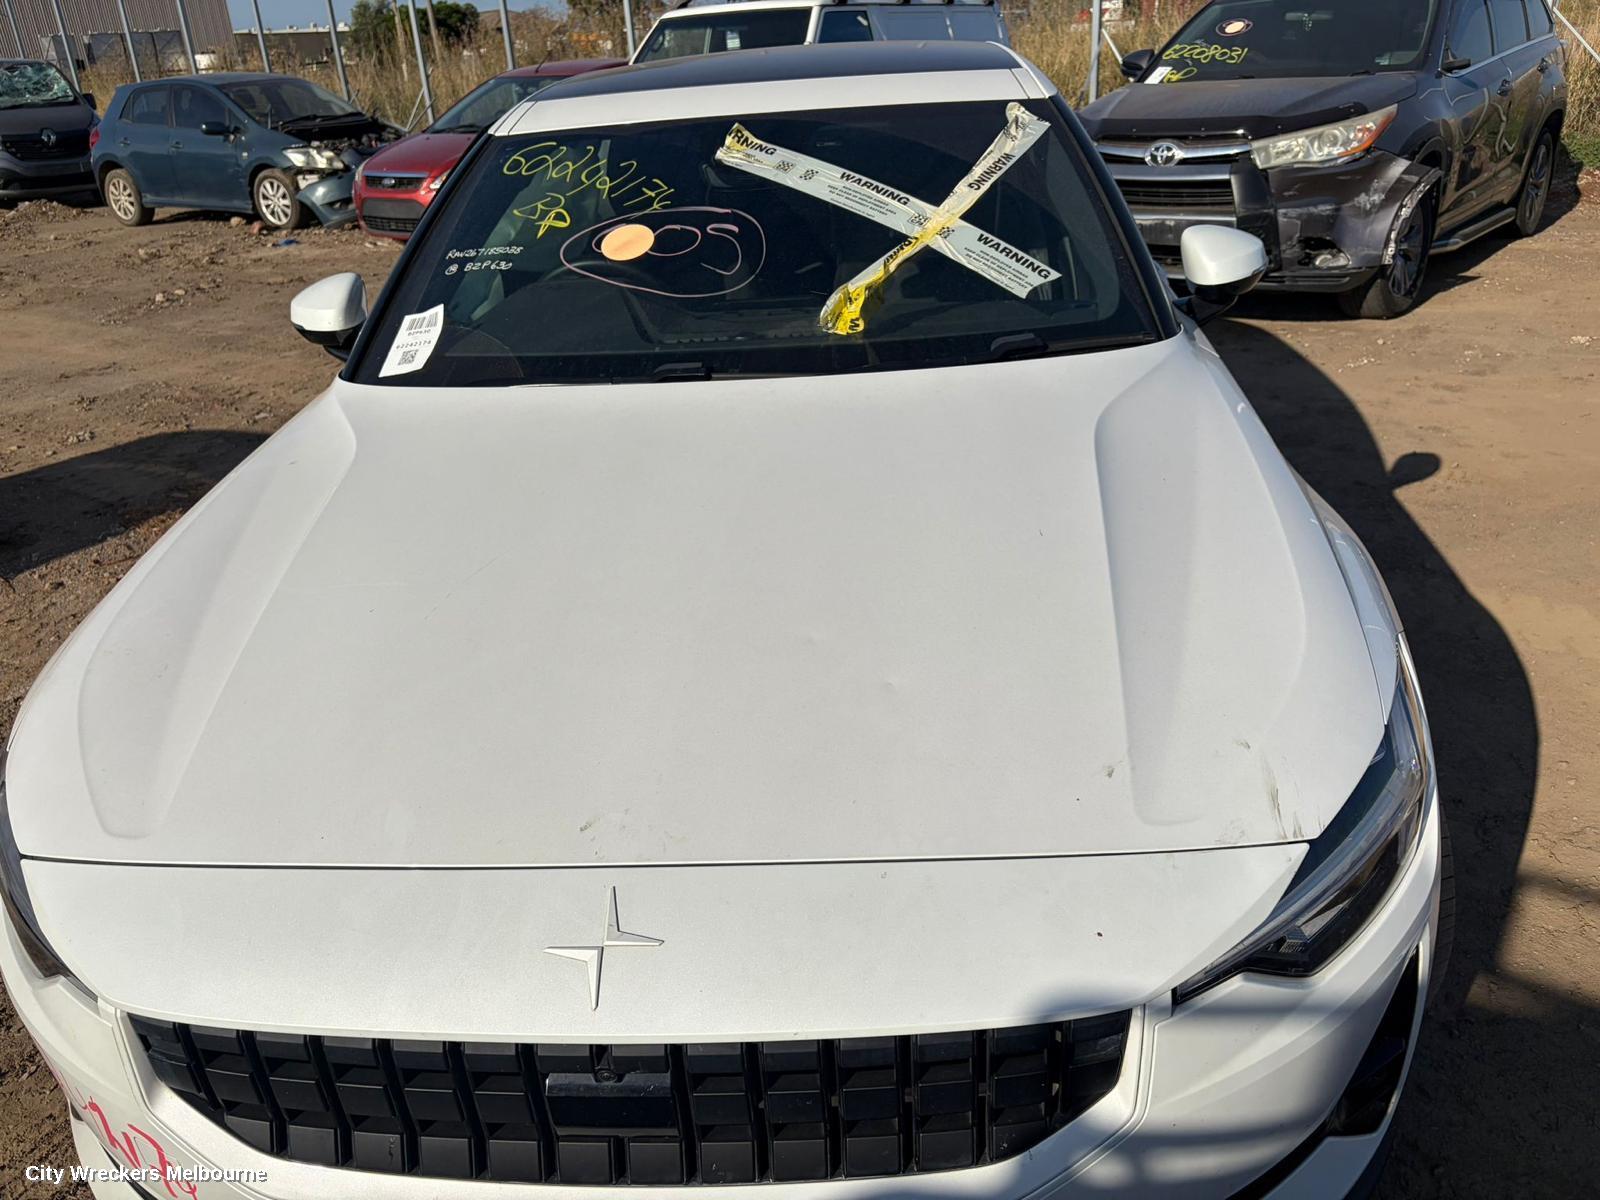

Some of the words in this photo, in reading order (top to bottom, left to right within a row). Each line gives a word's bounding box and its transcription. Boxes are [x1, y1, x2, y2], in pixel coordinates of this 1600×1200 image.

[728, 128, 777, 155] RNING
[840, 171, 910, 206] WARNING
[968, 152, 1016, 191] WARNING
[977, 233, 1051, 279] WARNING
